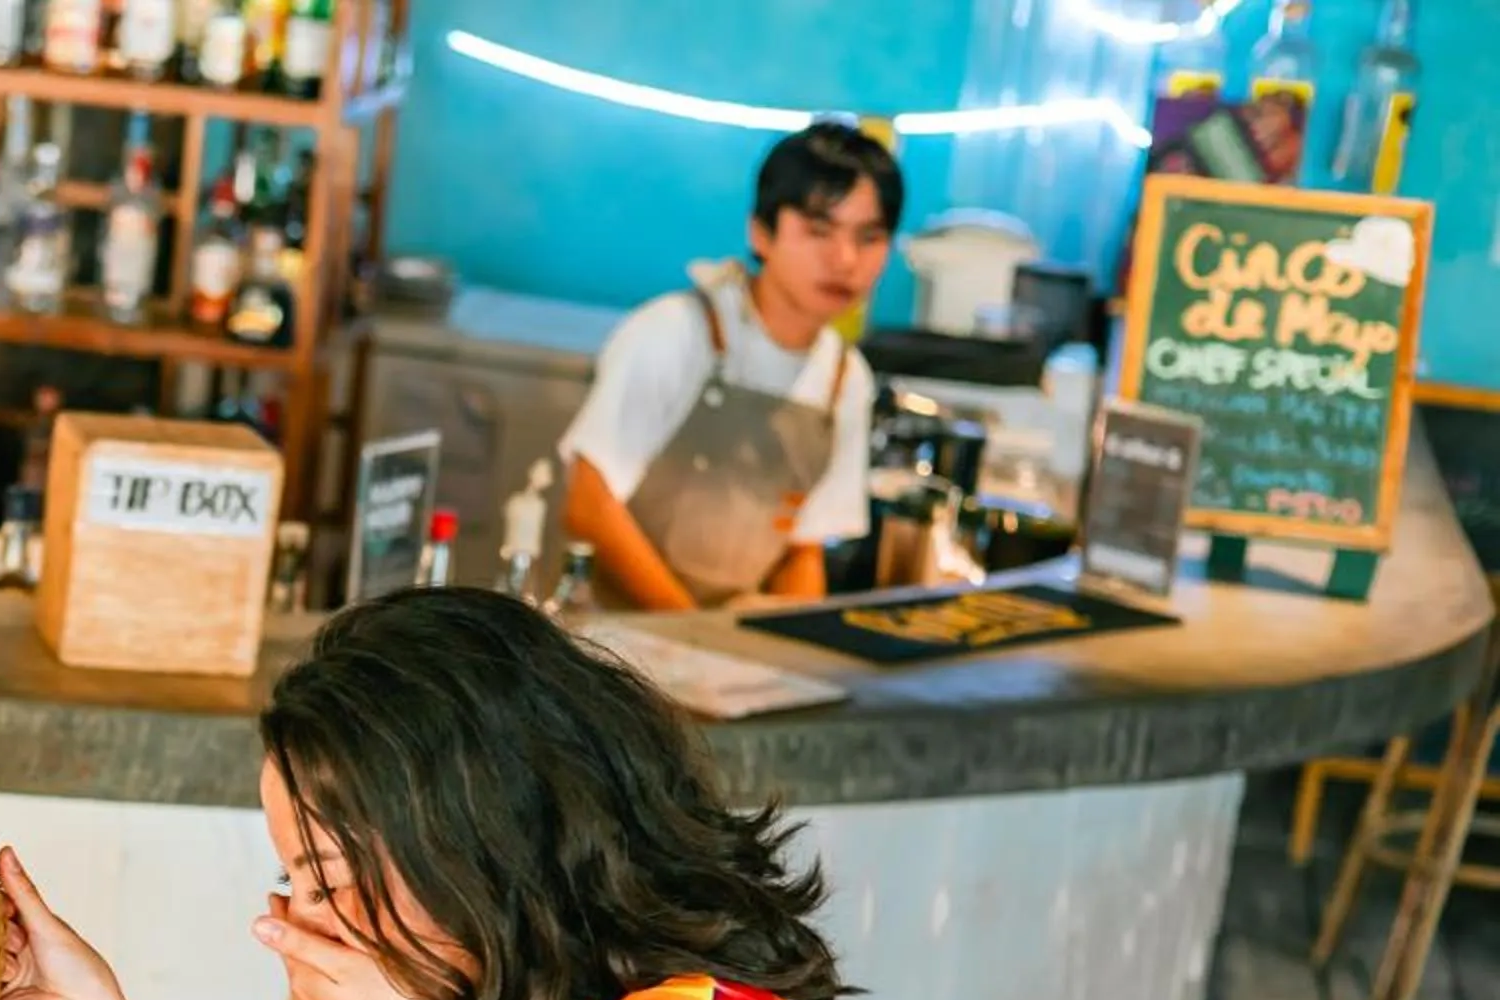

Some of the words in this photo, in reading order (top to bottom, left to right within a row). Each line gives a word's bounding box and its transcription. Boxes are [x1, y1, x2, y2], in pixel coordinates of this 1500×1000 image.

[1174, 222, 1367, 299] Cinco
[1146, 337, 1248, 386] CHEF
[1274, 293, 1399, 369] Mayo
[179, 480, 260, 524] BOX
